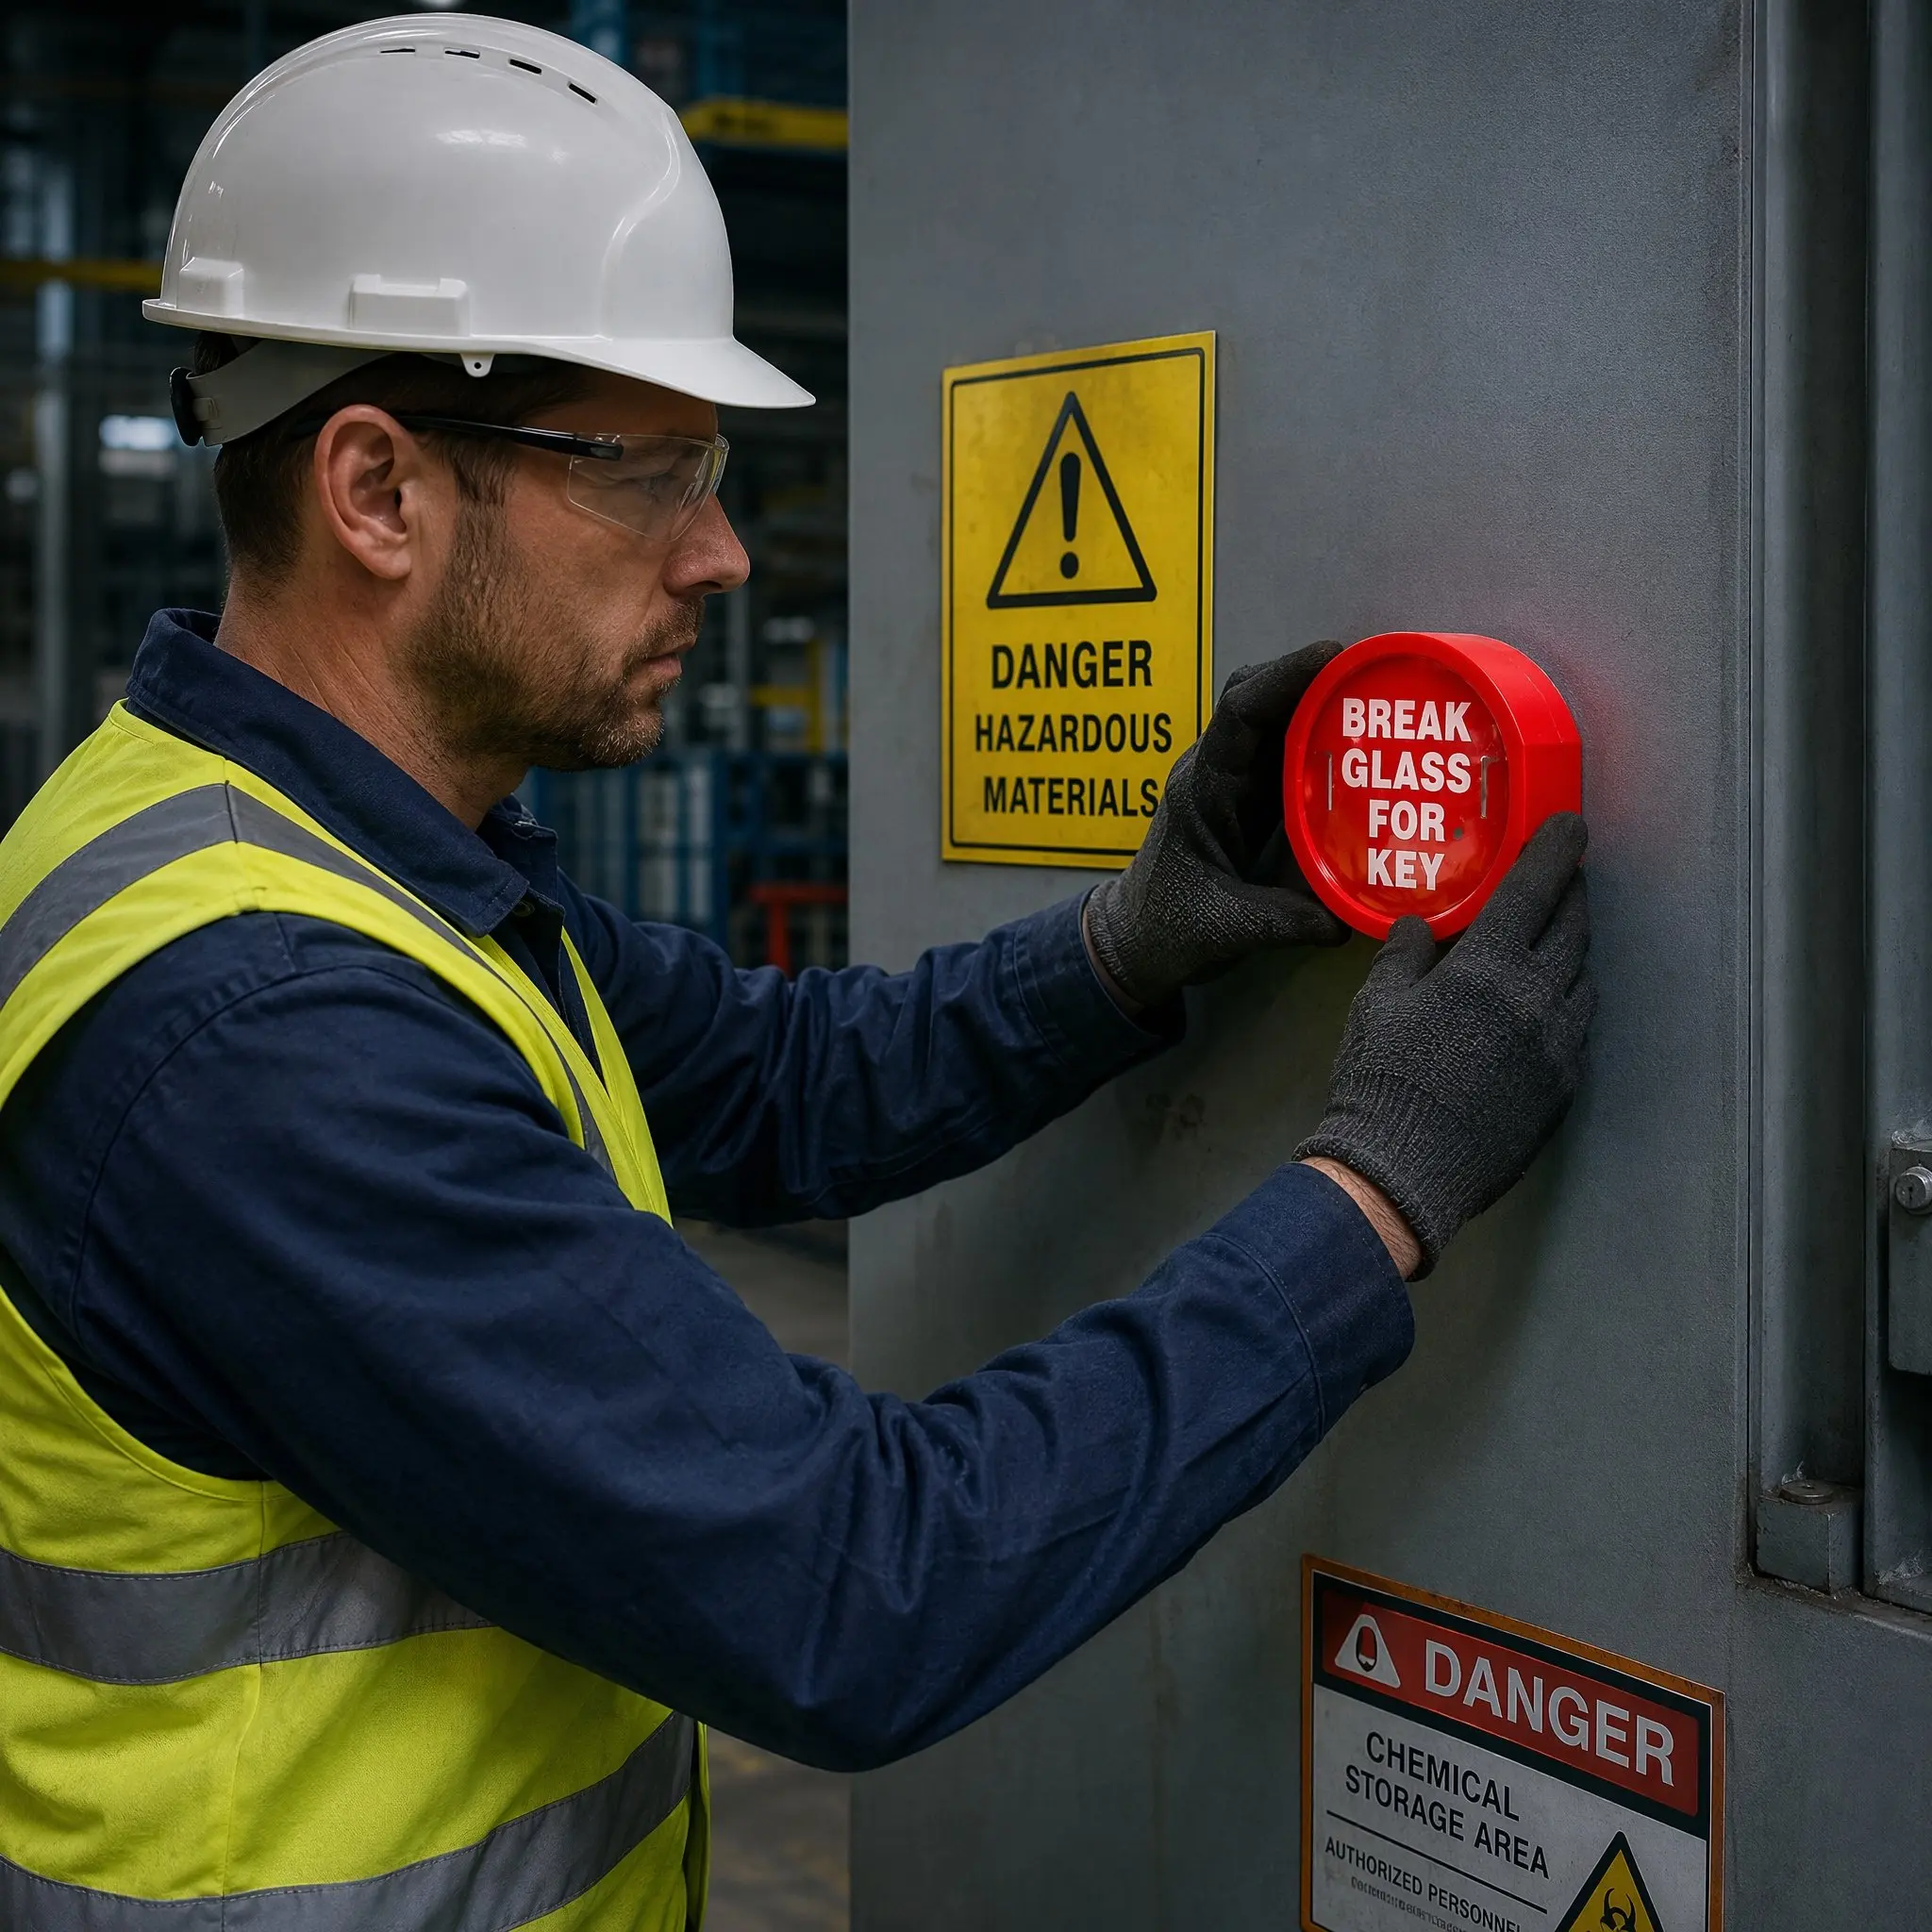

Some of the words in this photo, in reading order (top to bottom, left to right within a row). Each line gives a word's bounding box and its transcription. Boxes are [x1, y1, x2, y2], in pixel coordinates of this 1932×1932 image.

[991, 641, 1153, 689] DANGER
[975, 713, 1172, 753] HAZARDOUS
[1342, 698, 1472, 742] BREAK
[1341, 748, 1471, 793] GLASS
[983, 776, 1159, 818] MATERIALS
[1369, 799, 1445, 841] FOR
[1367, 847, 1445, 891] KEY
[1424, 1639, 1674, 1788] DANGER
[1366, 1731, 1520, 1822] CHEMICAL
[1345, 1765, 1465, 1841] STORAGE
[1474, 1822, 1550, 1880] AREA
[1324, 1836, 1423, 1896] AUTHORIZED
